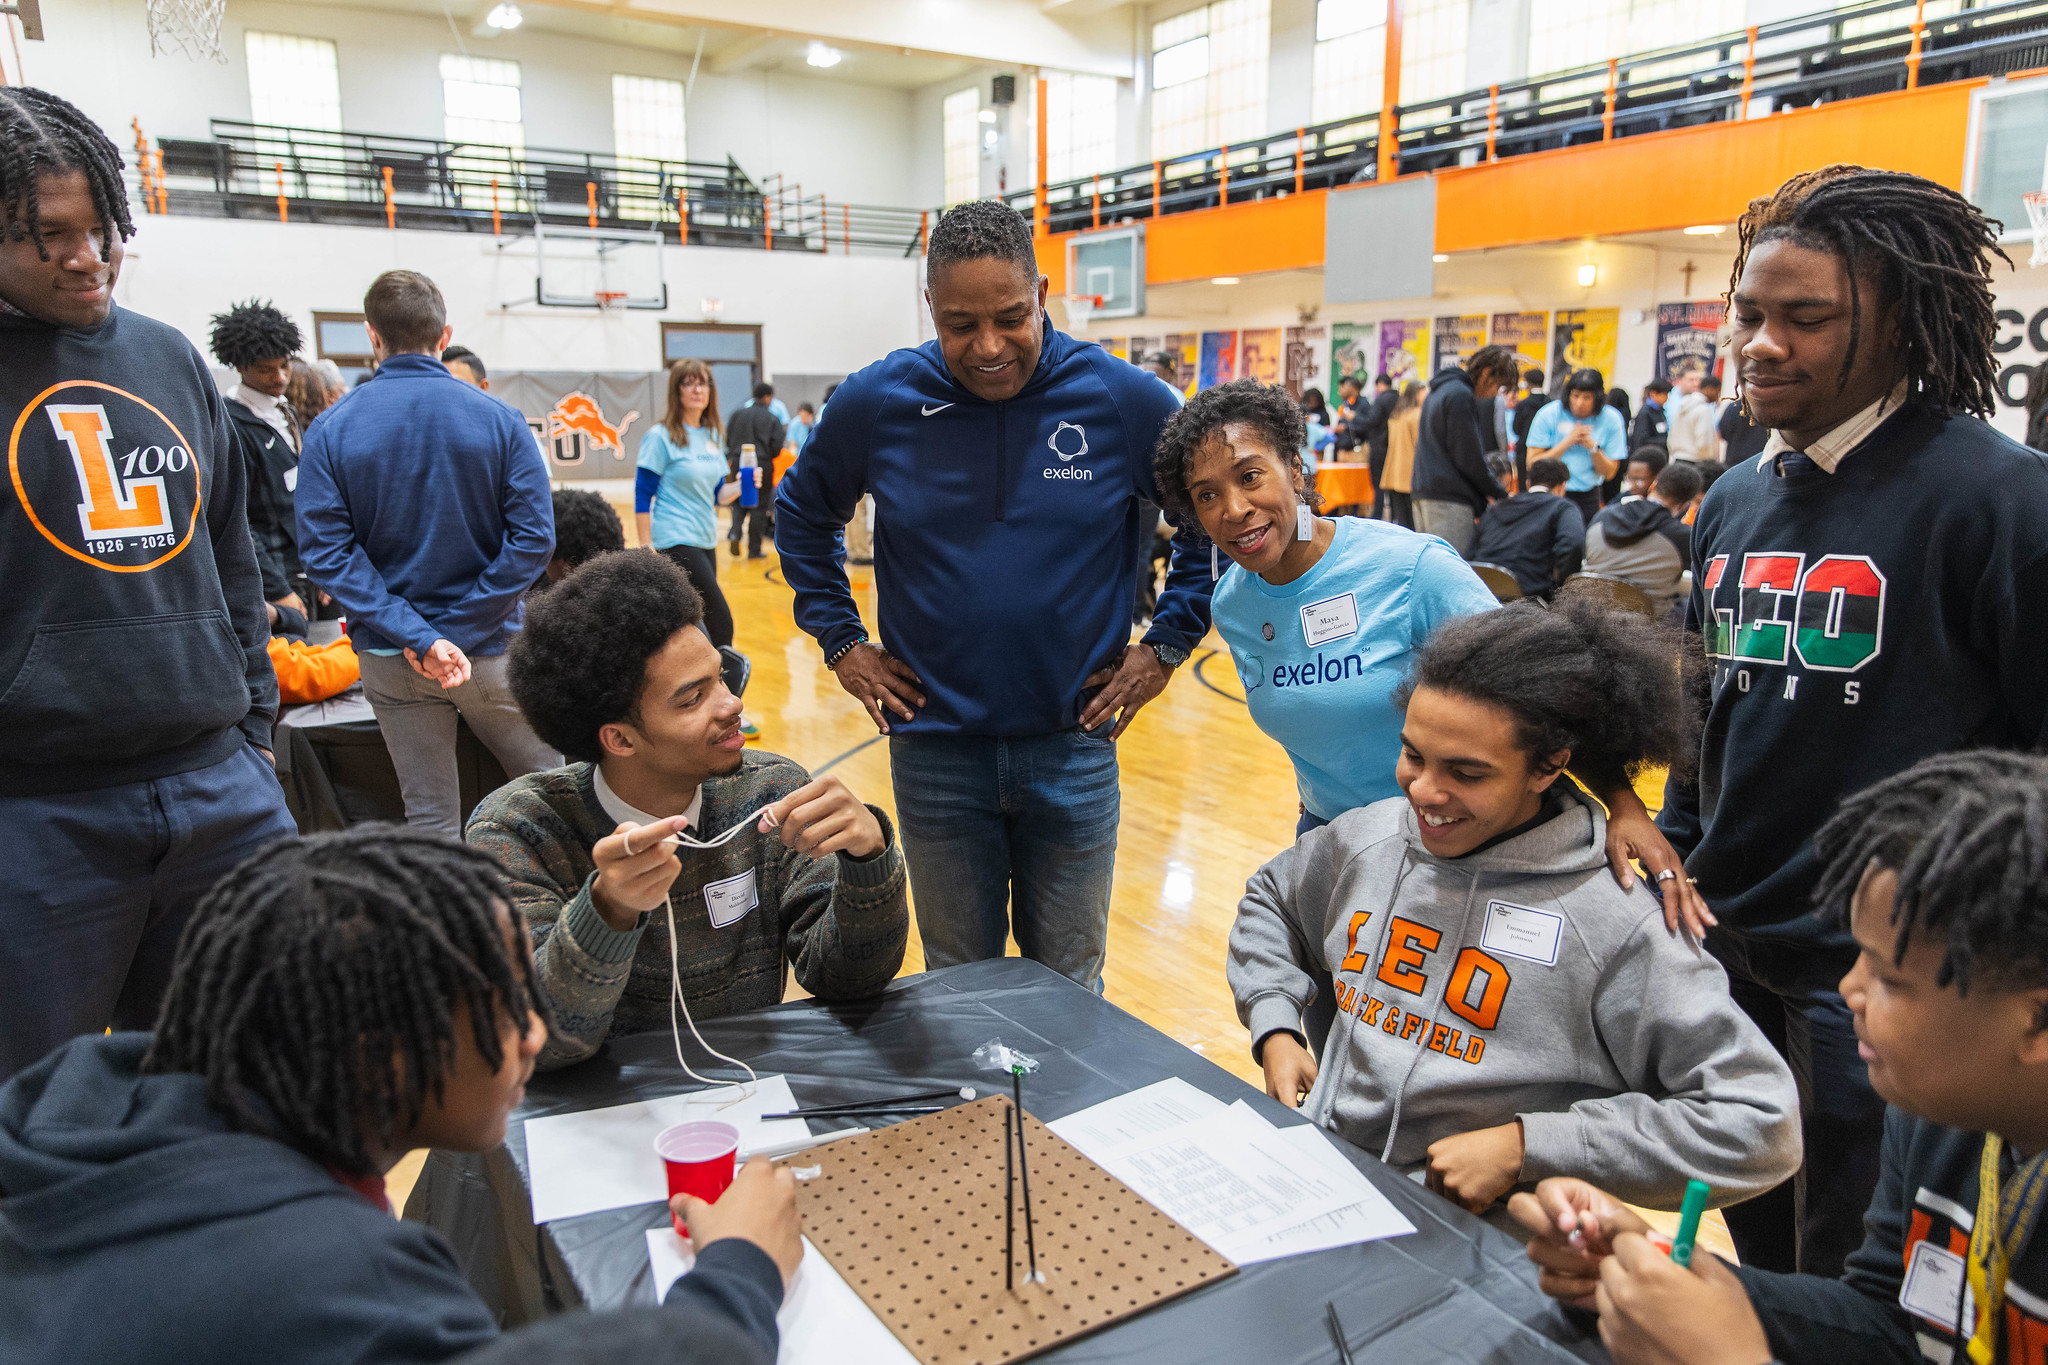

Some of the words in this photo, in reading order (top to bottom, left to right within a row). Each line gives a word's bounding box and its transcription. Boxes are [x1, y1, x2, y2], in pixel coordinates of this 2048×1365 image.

[45, 404, 174, 541] L
[119, 445, 188, 477] 100
[1043, 464, 1093, 481] exelon
[86, 539, 124, 554] 1926
[141, 534, 176, 549] 2026
[1319, 615, 1340, 626] Maya
[1272, 652, 1363, 687] exelon
[1340, 910, 1512, 1031] LEO
[1382, 1005, 1400, 1036] &
[1400, 1012, 1487, 1065] FIELD
